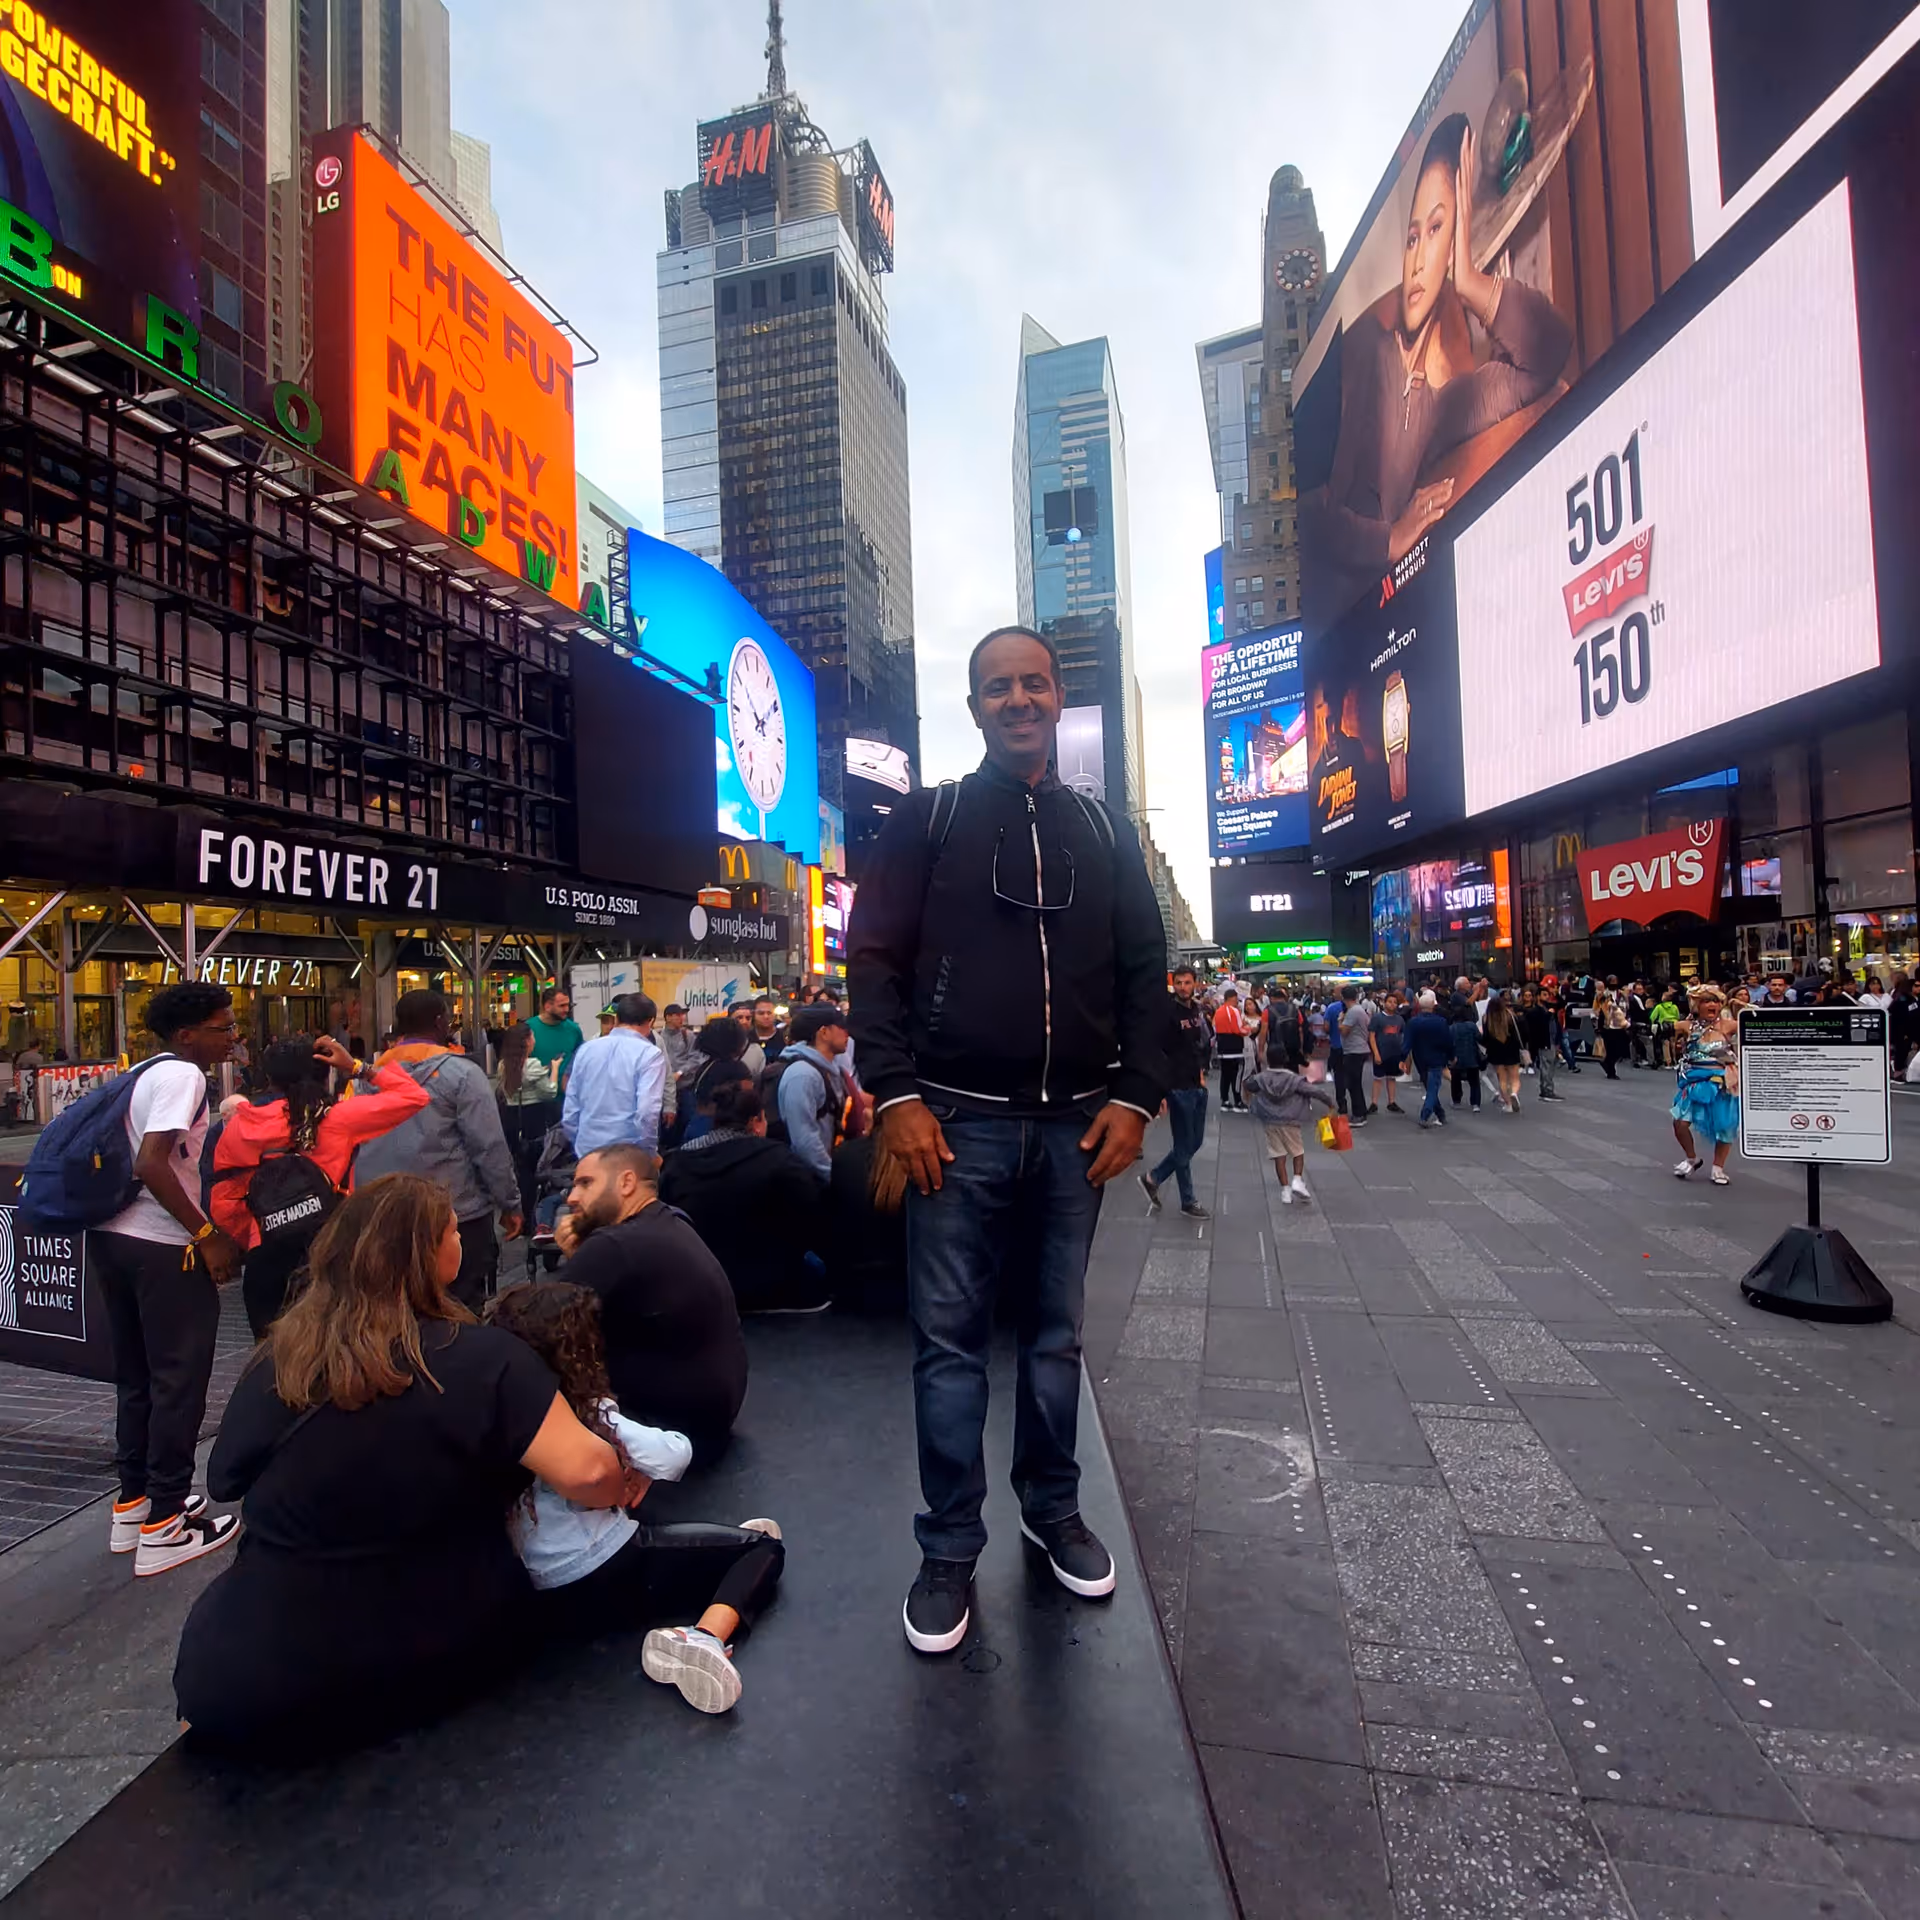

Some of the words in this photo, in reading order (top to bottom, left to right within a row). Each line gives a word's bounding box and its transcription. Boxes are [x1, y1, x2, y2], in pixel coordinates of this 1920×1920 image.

[704, 122, 772, 187] H&M
[318, 191, 340, 213] LG
[869, 174, 894, 249] H&M
[386, 201, 489, 343] THE
[503, 311, 573, 415] FUT
[389, 269, 486, 393] HAS
[387, 334, 547, 497] MANY
[387, 406, 569, 578] FACES!
[1566, 427, 1643, 566] 501
[1395, 536, 1429, 576] MARRIOTT
[1396, 554, 1425, 589] MARQUIS
[1210, 650, 1235, 667] THE
[1211, 665, 1228, 679] OF
[1229, 662, 1239, 674] A
[1240, 645, 1298, 671] LIFETIME
[1211, 679, 1226, 690] FOR
[1227, 673, 1250, 686] LOCAL
[1251, 660, 1298, 679] BUSINESSES
[1211, 690, 1226, 700] FOR
[1227, 679, 1268, 696] BROADWAY
[1212, 701, 1227, 710] FOR
[1228, 696, 1241, 707] ALL
[1241, 694, 1252, 703] OF
[1253, 690, 1265, 699] US
[1217, 814, 1250, 826] Caesars
[1250, 810, 1279, 821] Palace
[1217, 825, 1242, 835] Times
[1242, 820, 1272, 831] Square
[199, 828, 390, 905] FOREVER
[407, 864, 439, 911] 21
[545, 886, 570, 907] U.S.
[571, 890, 606, 912] POLO
[608, 896, 640, 916] ASSN.
[1250, 894, 1293, 911] BT21
[574, 911, 598, 925] SINCE
[710, 912, 758, 944] sunglass
[759, 919, 778, 942] hut
[163, 957, 281, 987] FREVER
[290, 959, 313, 986] 21
[580, 979, 609, 989] United
[684, 989, 719, 1009] United
[264, 1209, 287, 1232] STEVE
[286, 1195, 322, 1224] MADDEN
[23, 1236, 72, 1259] TIMES
[20, 1262, 77, 1288] SQUARE
[25, 1291, 74, 1312] ALLIANCE
